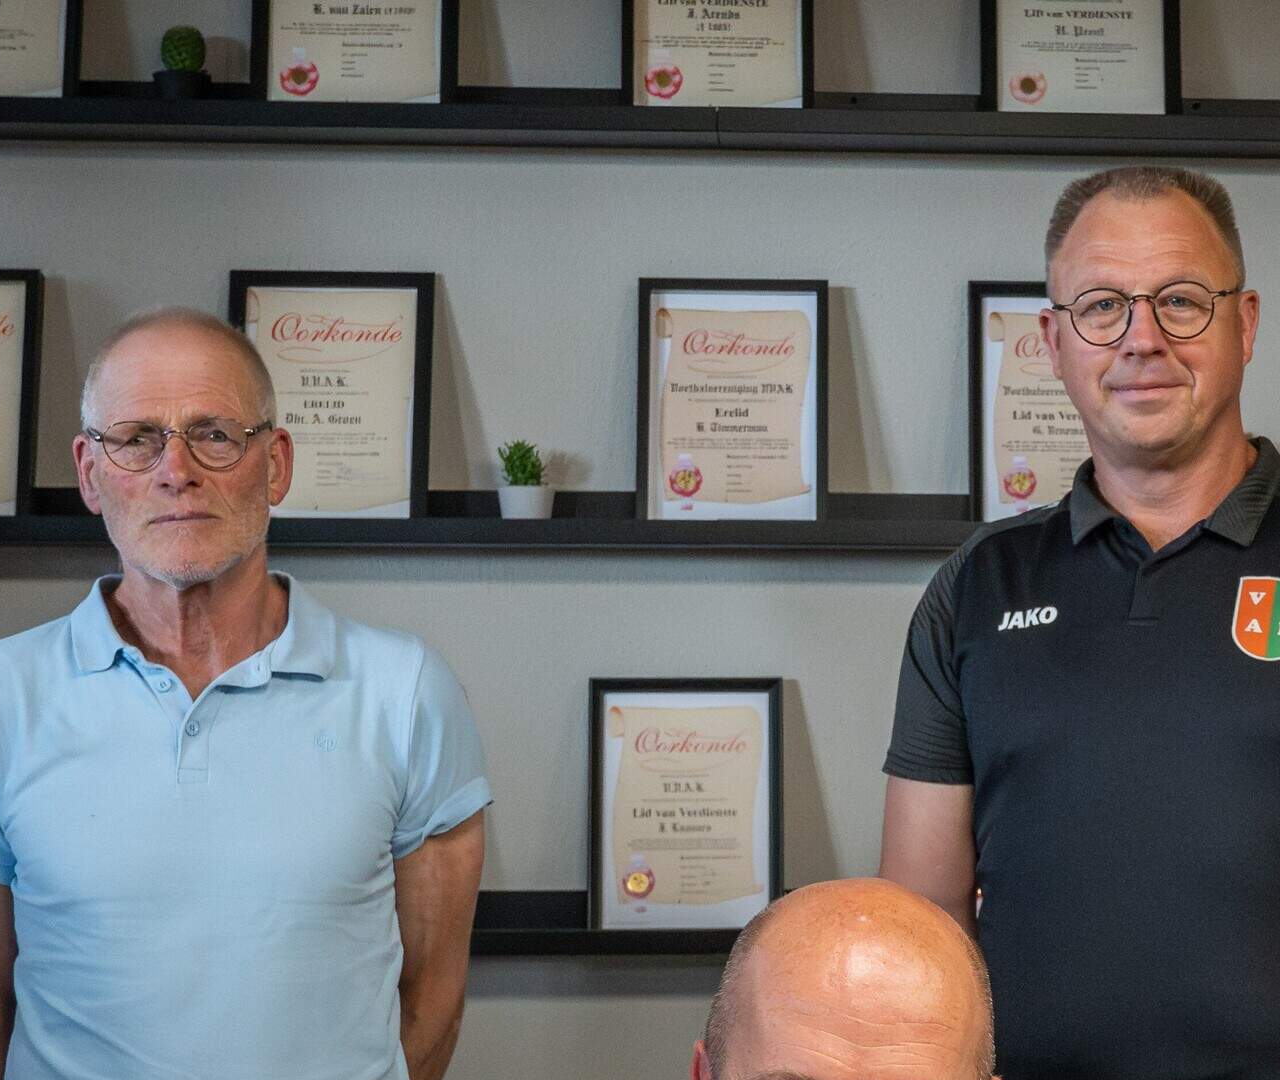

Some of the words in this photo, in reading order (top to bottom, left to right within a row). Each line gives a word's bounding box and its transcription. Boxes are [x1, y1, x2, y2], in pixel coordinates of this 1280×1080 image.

[1024, 9, 1044, 18] LID
[1067, 10, 1135, 20] VERDIENSTE
[271, 311, 403, 345] Oorkonde
[683, 328, 796, 357] Oorkonde
[714, 408, 750, 418] Erelid
[1013, 411, 1031, 420] Lid
[1035, 413, 1055, 421] van
[1059, 411, 1082, 421] Ver
[1248, 591, 1267, 606] V
[998, 606, 1058, 631] JAKO
[1244, 618, 1263, 633] A
[634, 728, 747, 755] Oorkonde
[632, 807, 652, 818] Lid
[655, 810, 676, 818] van
[679, 807, 738, 818] Verdienste
